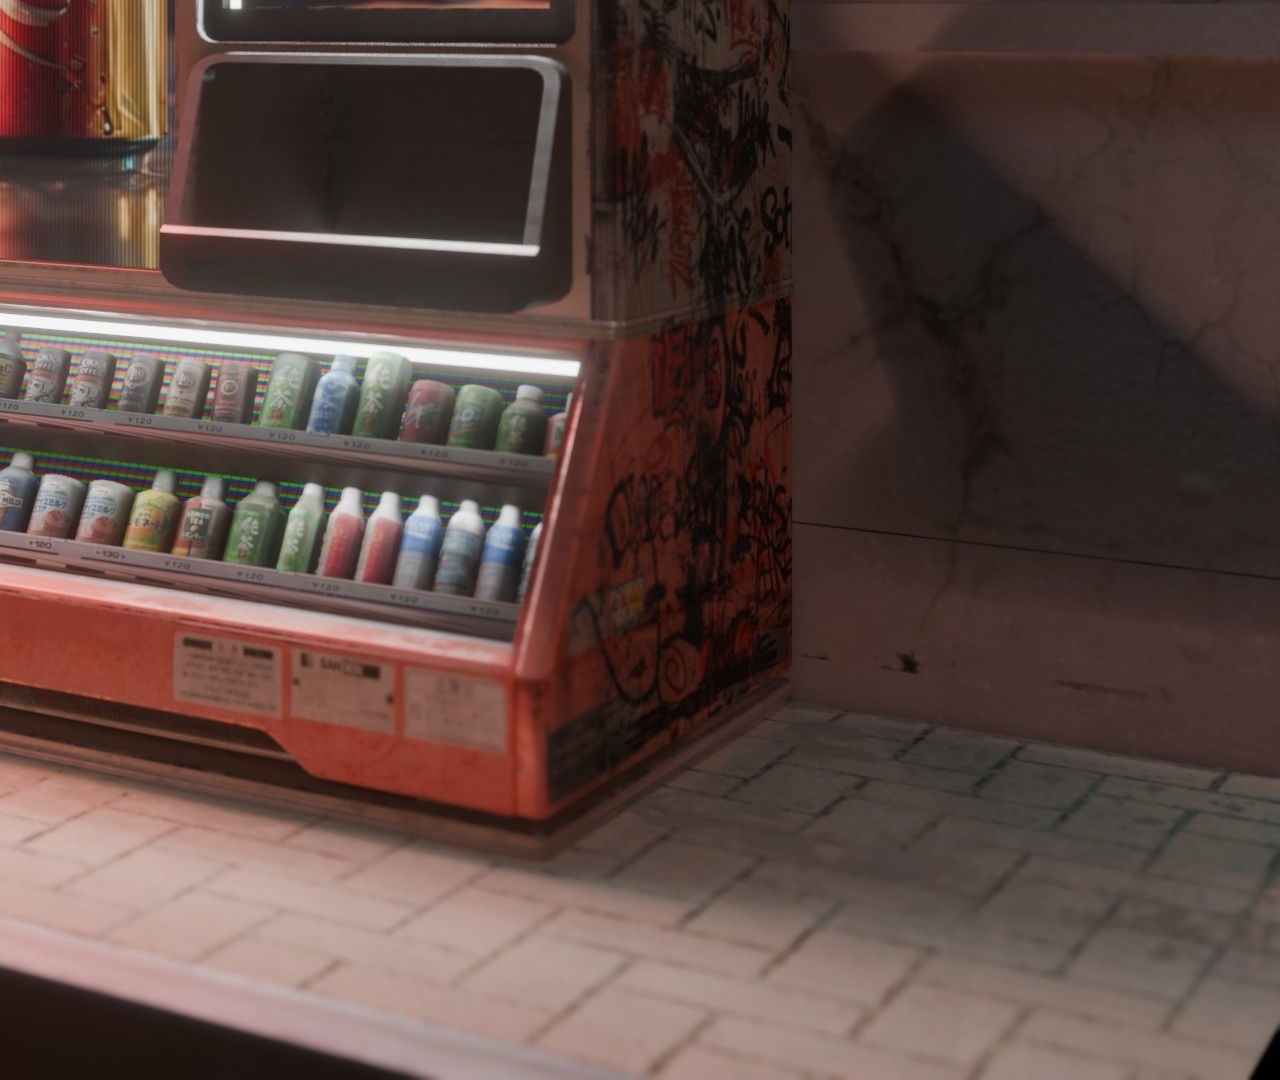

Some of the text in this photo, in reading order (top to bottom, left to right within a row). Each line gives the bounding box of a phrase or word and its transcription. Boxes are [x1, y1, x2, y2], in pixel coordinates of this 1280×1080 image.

[61, 409, 85, 418] ¥120
[128, 416, 152, 425] ¥120
[197, 424, 224, 433] ¥120
[269, 432, 296, 441] ¥120
[164, 560, 190, 570] ¥120
[237, 572, 264, 580] ¥120
